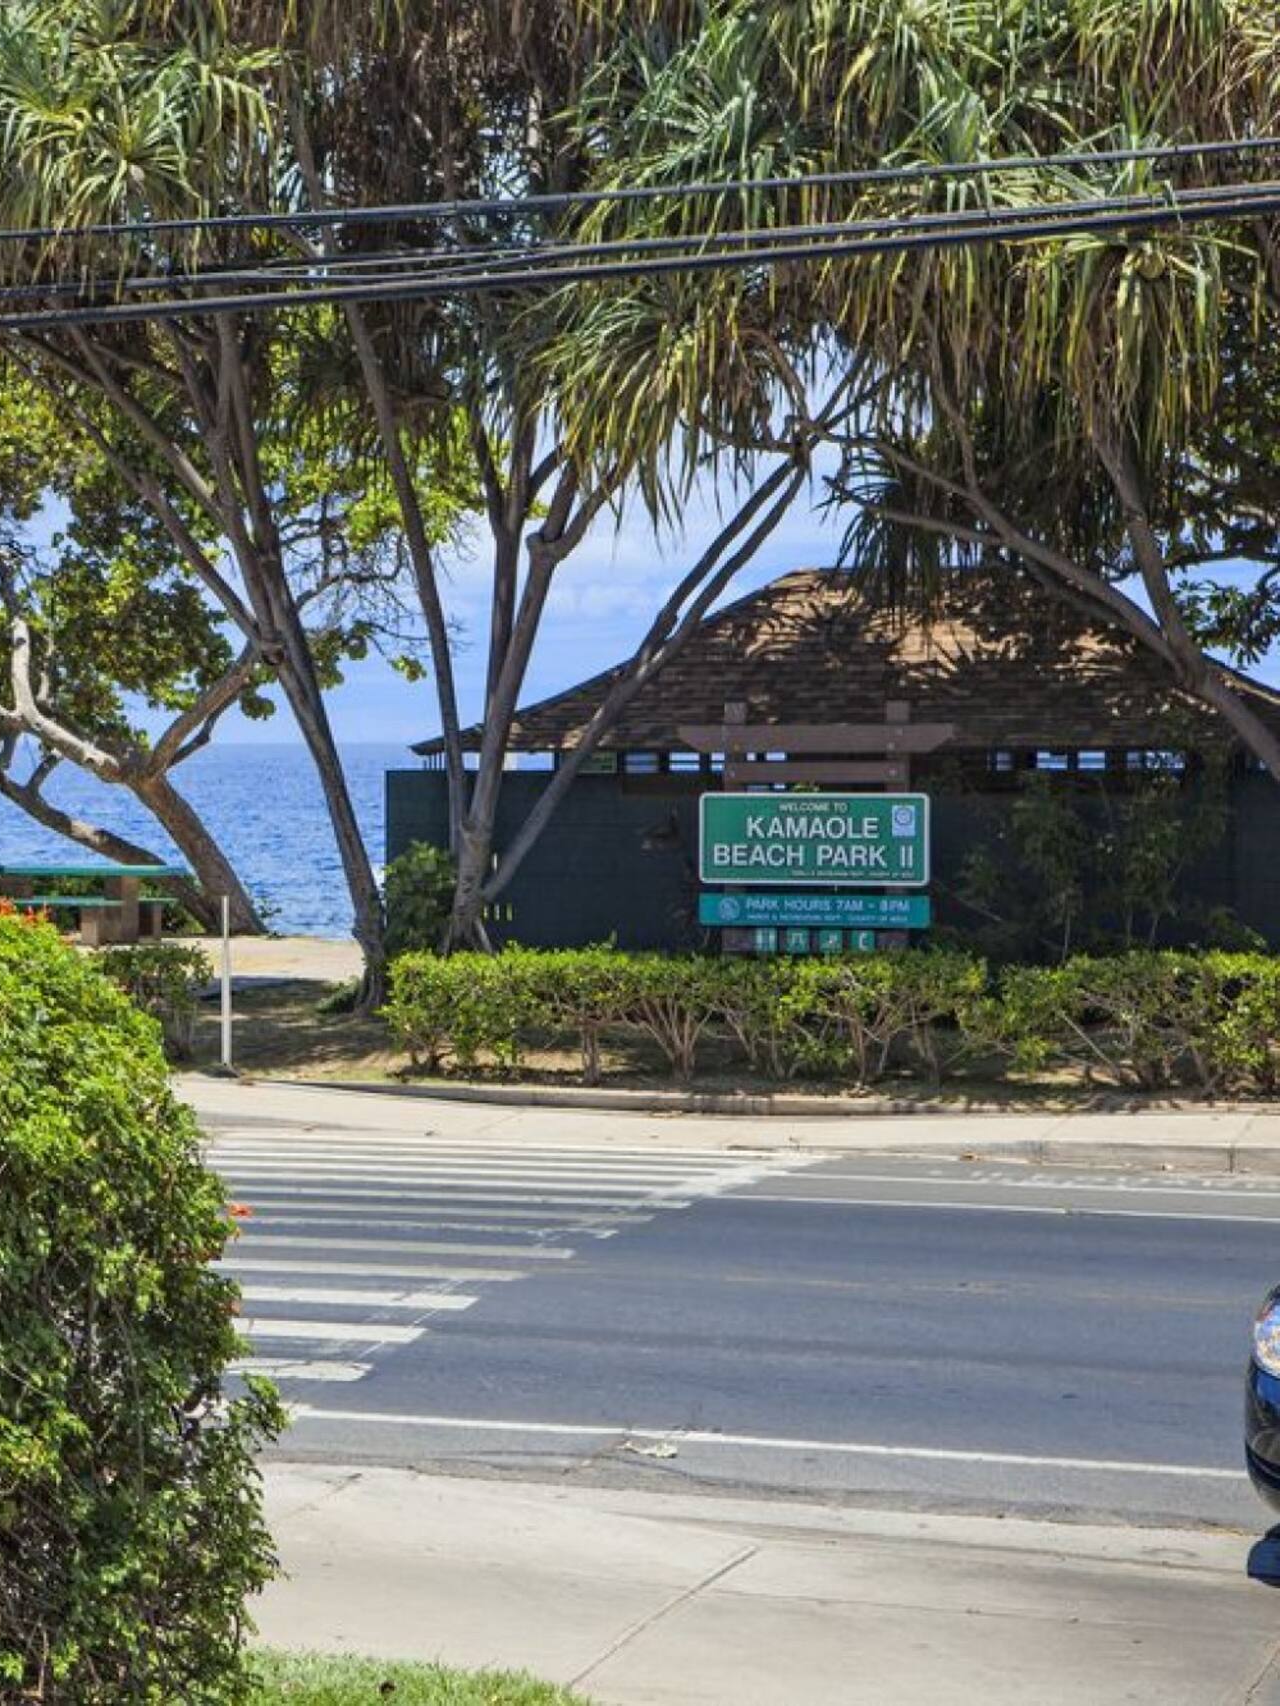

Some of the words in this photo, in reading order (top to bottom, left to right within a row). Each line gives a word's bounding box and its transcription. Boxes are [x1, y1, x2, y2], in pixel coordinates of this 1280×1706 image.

[779, 802, 829, 812] WELCOME
[833, 803, 848, 812] TO
[746, 816, 880, 839] KAMAOLE
[714, 844, 804, 867] BEACH
[817, 845, 887, 868] PARK
[900, 846, 913, 868] II
[746, 898, 780, 911] PARK
[784, 899, 831, 911] HOURS
[837, 900, 863, 911] 7AM
